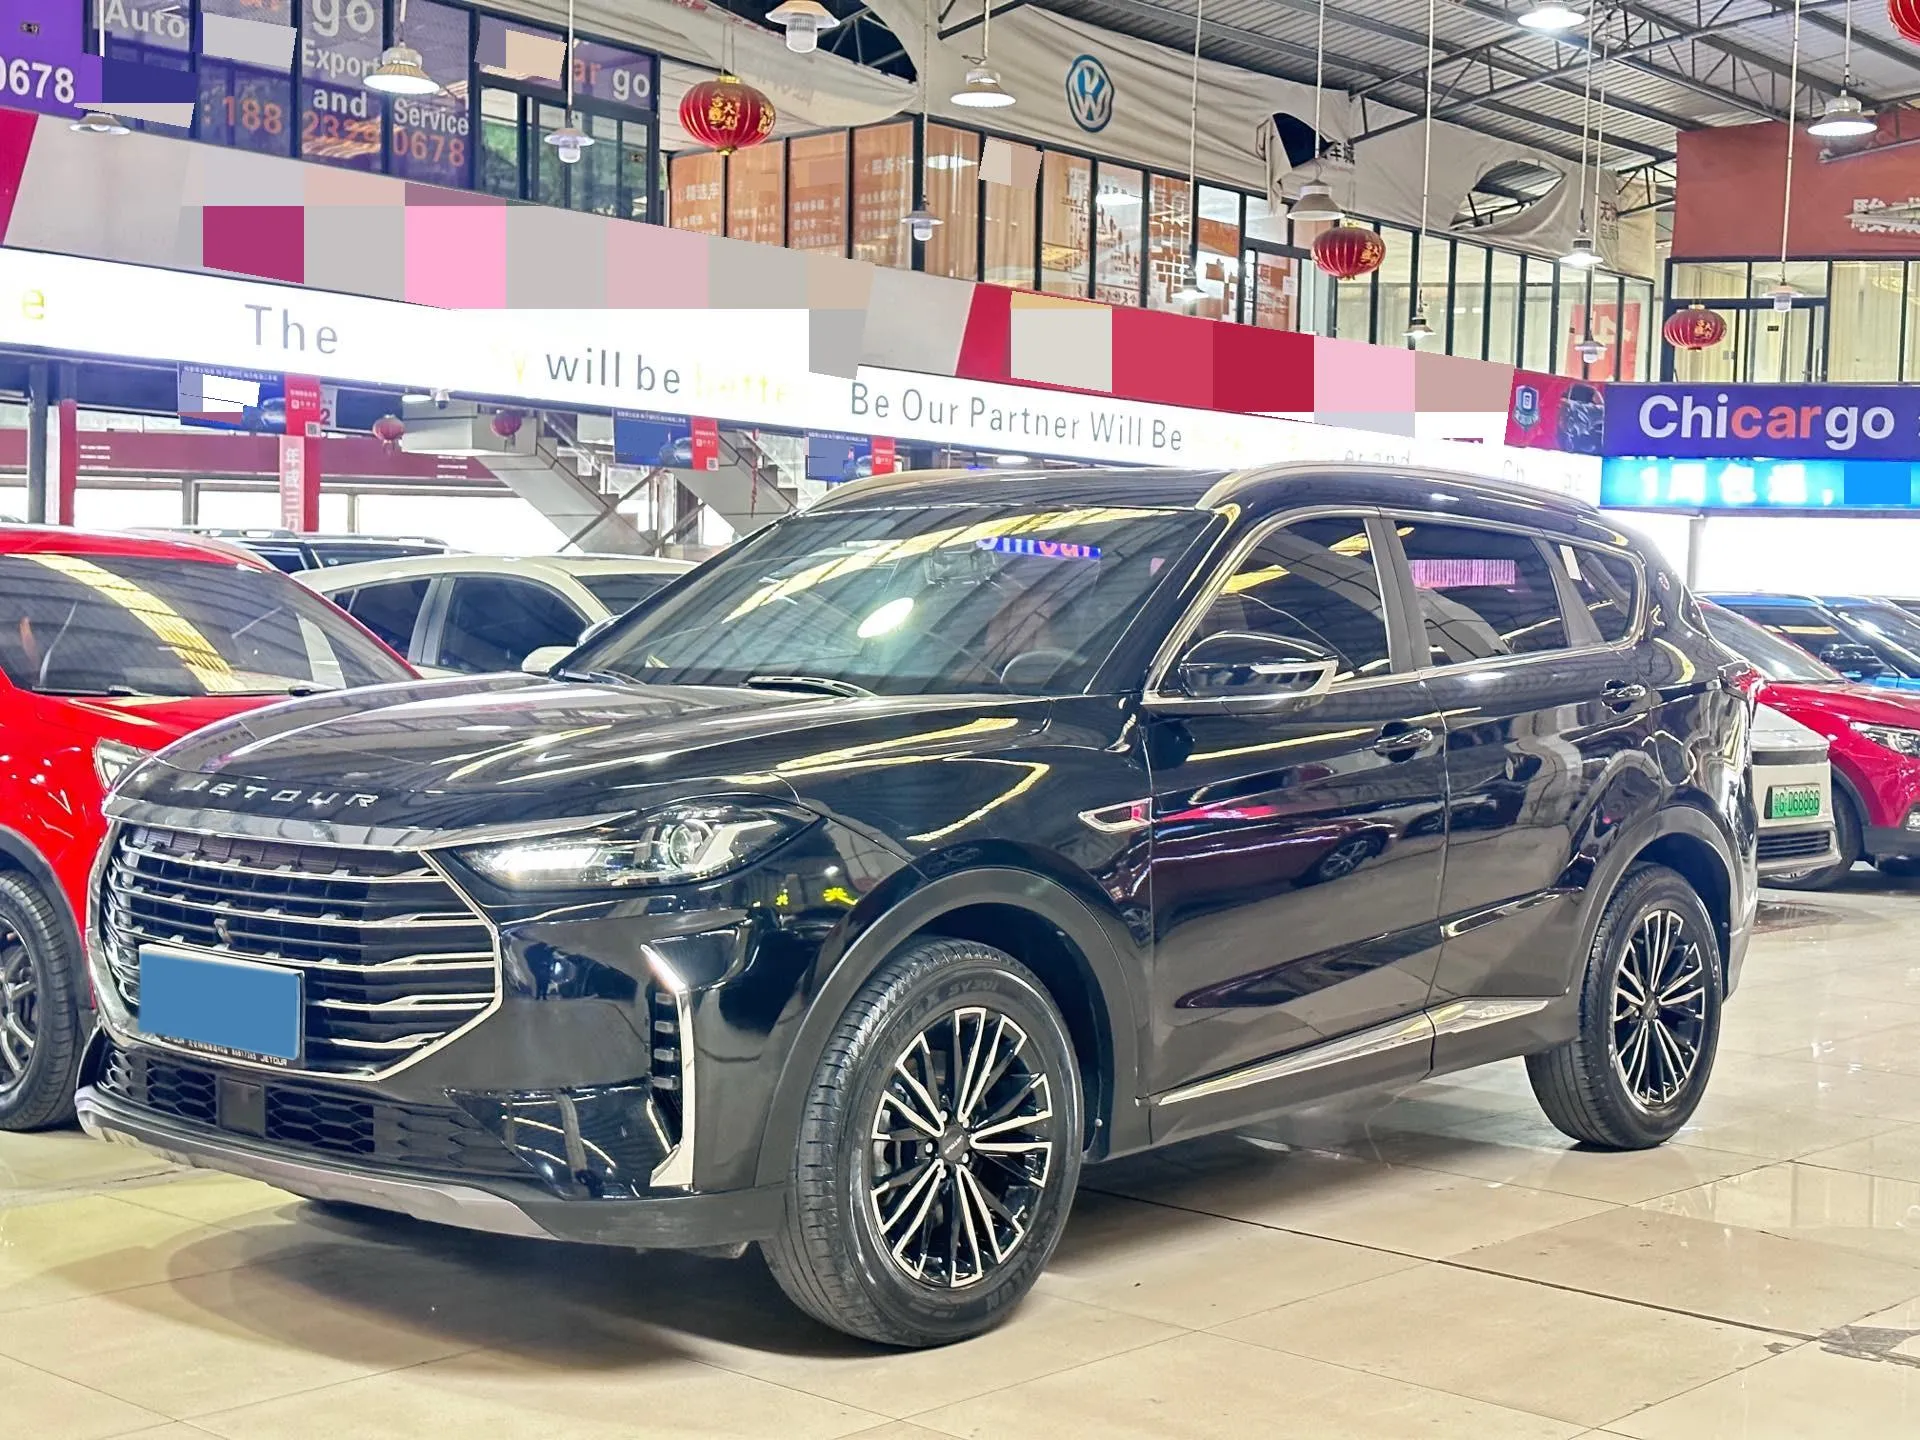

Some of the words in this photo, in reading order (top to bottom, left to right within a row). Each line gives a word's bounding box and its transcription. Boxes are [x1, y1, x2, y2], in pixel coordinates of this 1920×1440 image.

[104, 0, 186, 38] Auto
[312, 88, 368, 118] and
[394, 98, 469, 136] Service
[394, 130, 465, 167] 0678
[244, 303, 338, 354] The
[546, 347, 621, 388] will
[636, 353, 681, 395] be
[849, 380, 890, 418] Be
[902, 388, 959, 427] Our
[970, 396, 1081, 440] Partner
[1091, 408, 1146, 447] Will
[1152, 420, 1183, 451] Be
[1639, 393, 1896, 450] Chicargo
[170, 779, 379, 808] JETOUR
